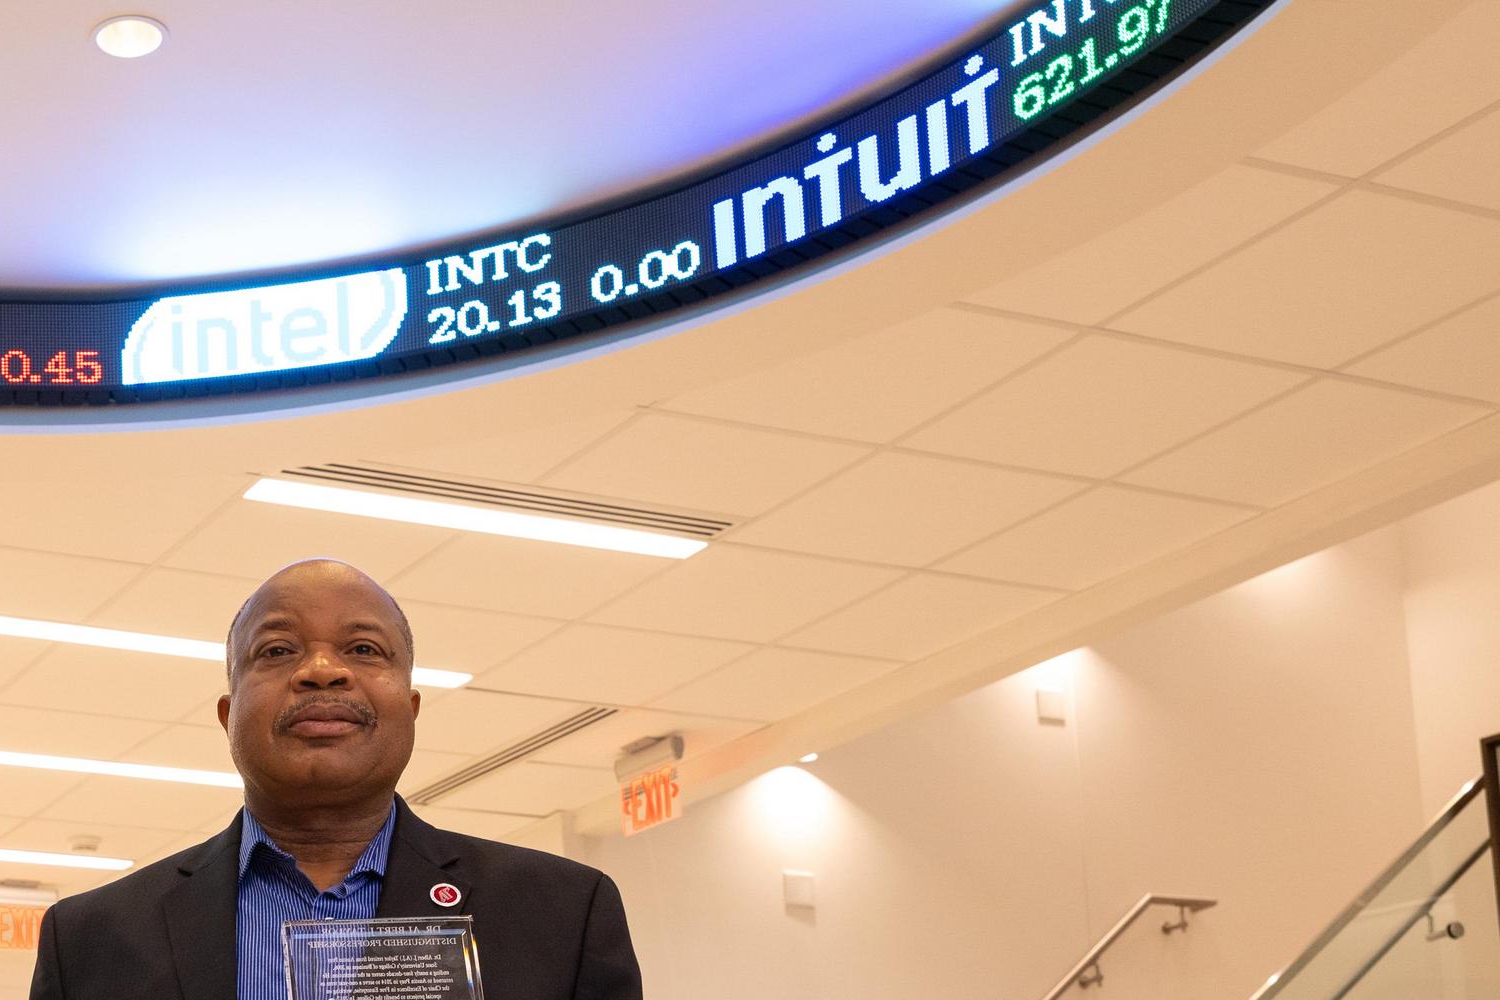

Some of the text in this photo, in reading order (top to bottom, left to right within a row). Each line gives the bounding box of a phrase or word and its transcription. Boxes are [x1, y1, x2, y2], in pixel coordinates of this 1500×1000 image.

[713, 54, 999, 269] intuit
[425, 233, 551, 296] INTC
[427, 241, 701, 345] 20.13 0.00
[0, 350, 103, 384] 0.45
[171, 281, 352, 376] intel
